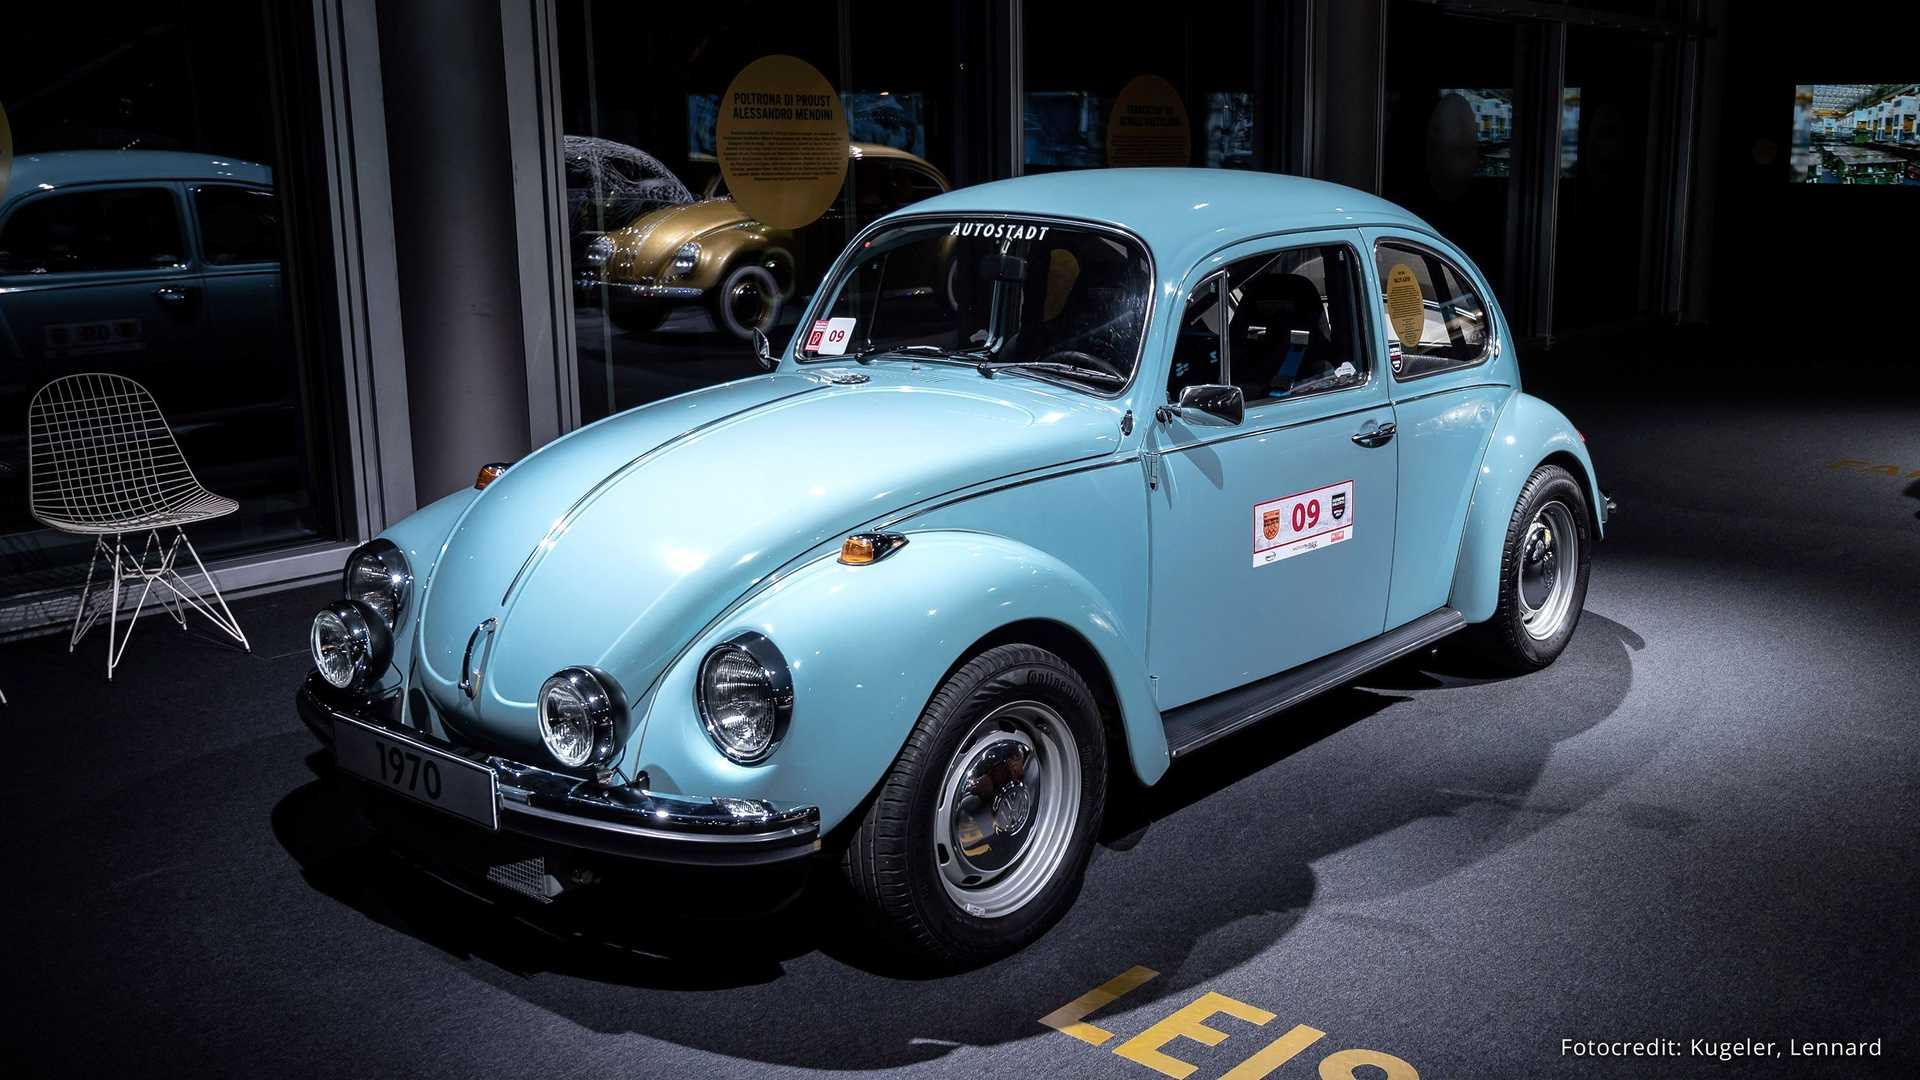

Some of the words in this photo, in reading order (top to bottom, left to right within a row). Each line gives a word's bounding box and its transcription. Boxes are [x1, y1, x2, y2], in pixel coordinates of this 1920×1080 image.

[734, 93, 782, 106] POLTRONA
[785, 94, 793, 106] DI
[796, 95, 831, 107] PROUST
[733, 107, 792, 120] ALESSANDRO
[796, 108, 833, 121] MENDINI
[950, 222, 1049, 241] AUTOSTADT
[828, 329, 845, 343] 09
[1292, 498, 1321, 532] 09
[375, 740, 442, 800] 1970
